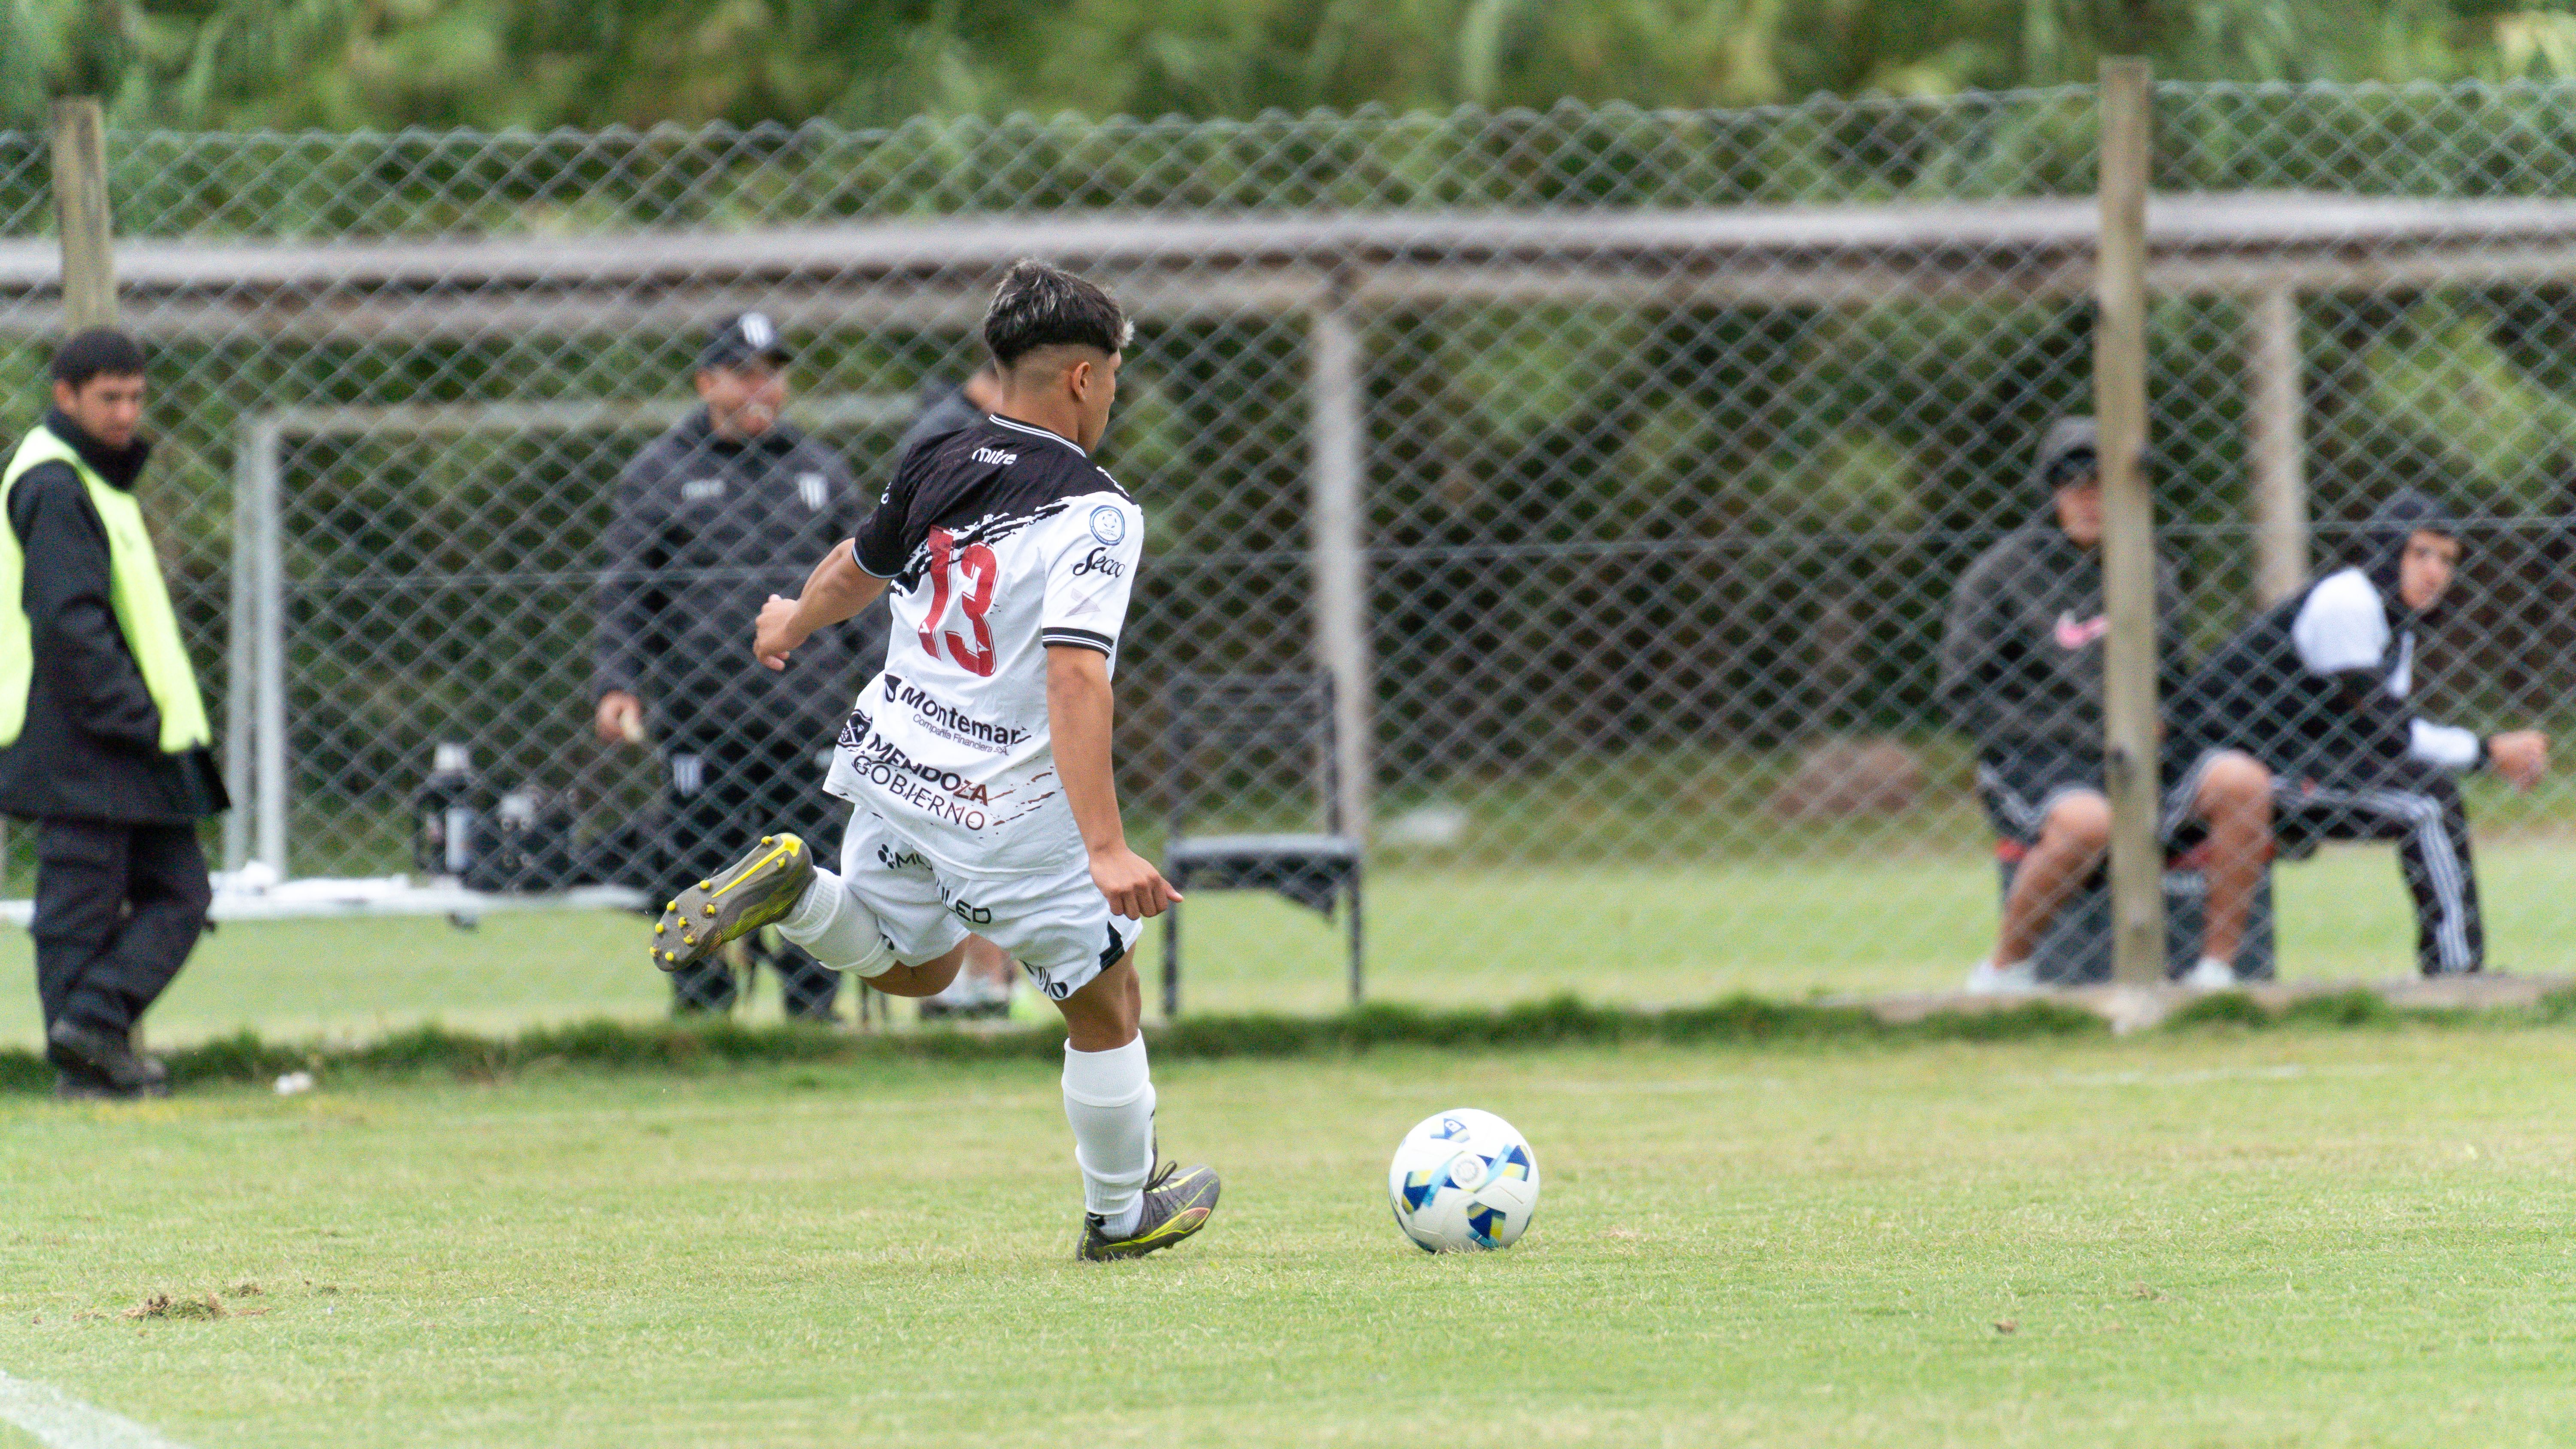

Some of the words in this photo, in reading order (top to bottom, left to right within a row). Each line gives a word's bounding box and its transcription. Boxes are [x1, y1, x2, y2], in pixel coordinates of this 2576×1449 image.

[972, 447, 1017, 465] mitre
[1073, 547, 1125, 578] Secco
[918, 524, 999, 677] 13
[900, 686, 1021, 746] Montemar
[854, 755, 985, 831] GOBIERNO
[867, 733, 988, 806] MENDOZA
